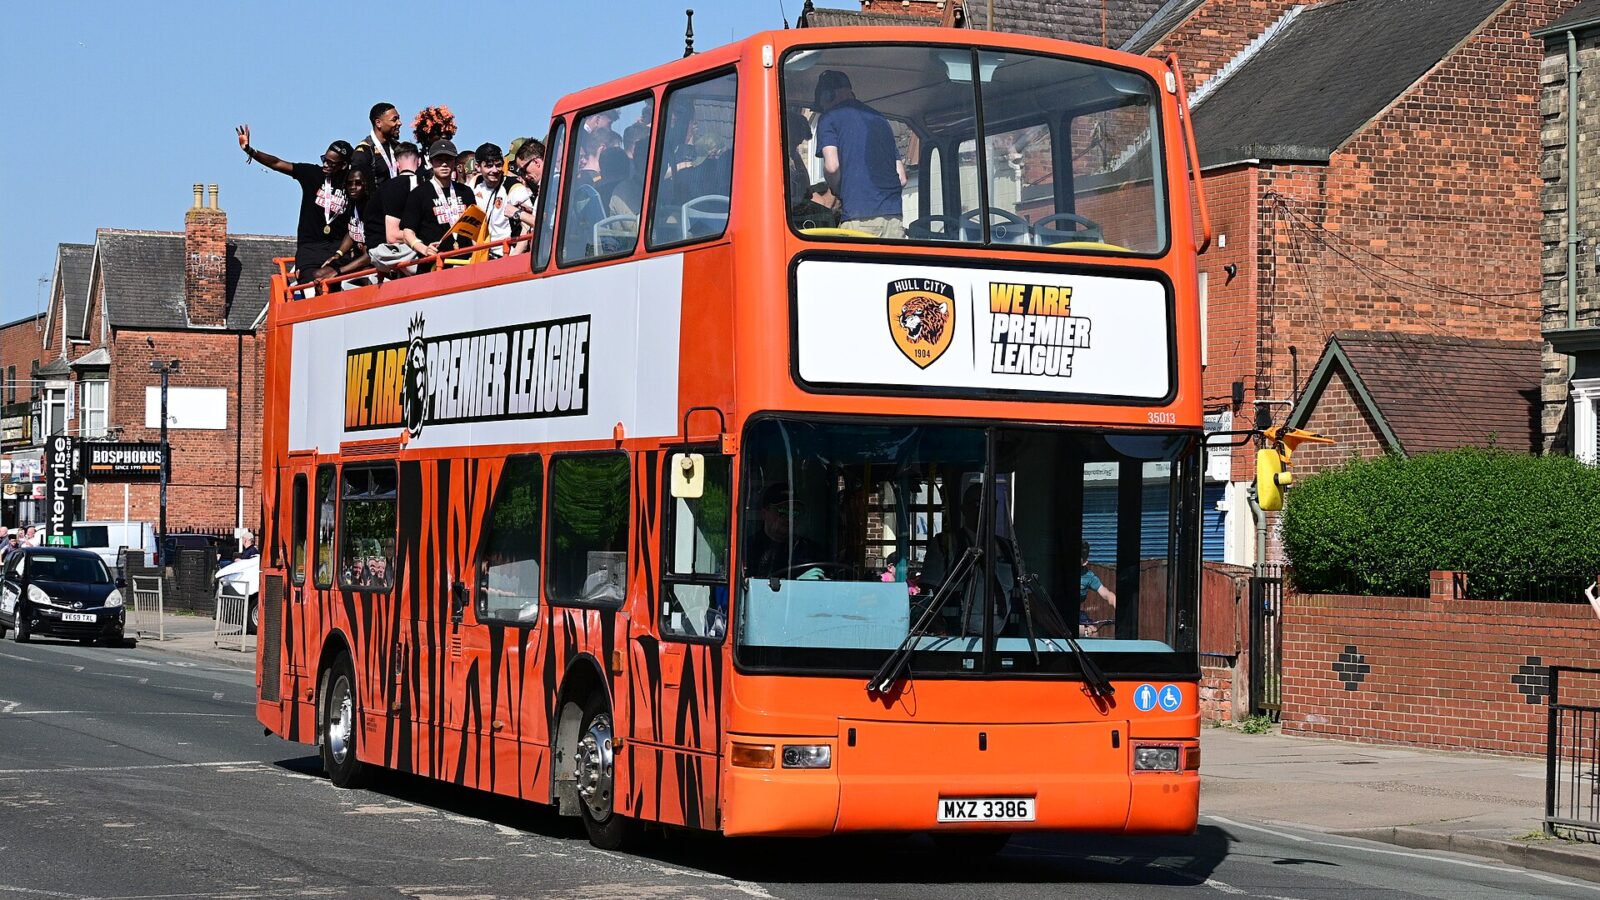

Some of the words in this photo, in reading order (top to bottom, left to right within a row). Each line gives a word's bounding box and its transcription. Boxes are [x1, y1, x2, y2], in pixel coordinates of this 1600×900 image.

[894, 280, 919, 292] HULL
[923, 280, 947, 294] CITY
[990, 282, 1026, 313] WE
[1027, 285, 1072, 317] ARE
[992, 314, 1091, 348] PREMIER
[914, 349, 931, 358] 1904
[992, 343, 1075, 377] LEAGUE
[345, 352, 372, 428] WE
[371, 347, 407, 425] ARE
[424, 332, 508, 420] PREMIER
[508, 321, 589, 414] LEAGUE
[1147, 411, 1176, 424] 35013
[92, 450, 162, 464] BOSPHORUS
[944, 801, 978, 819] MXZ
[983, 801, 1028, 818] 3386
